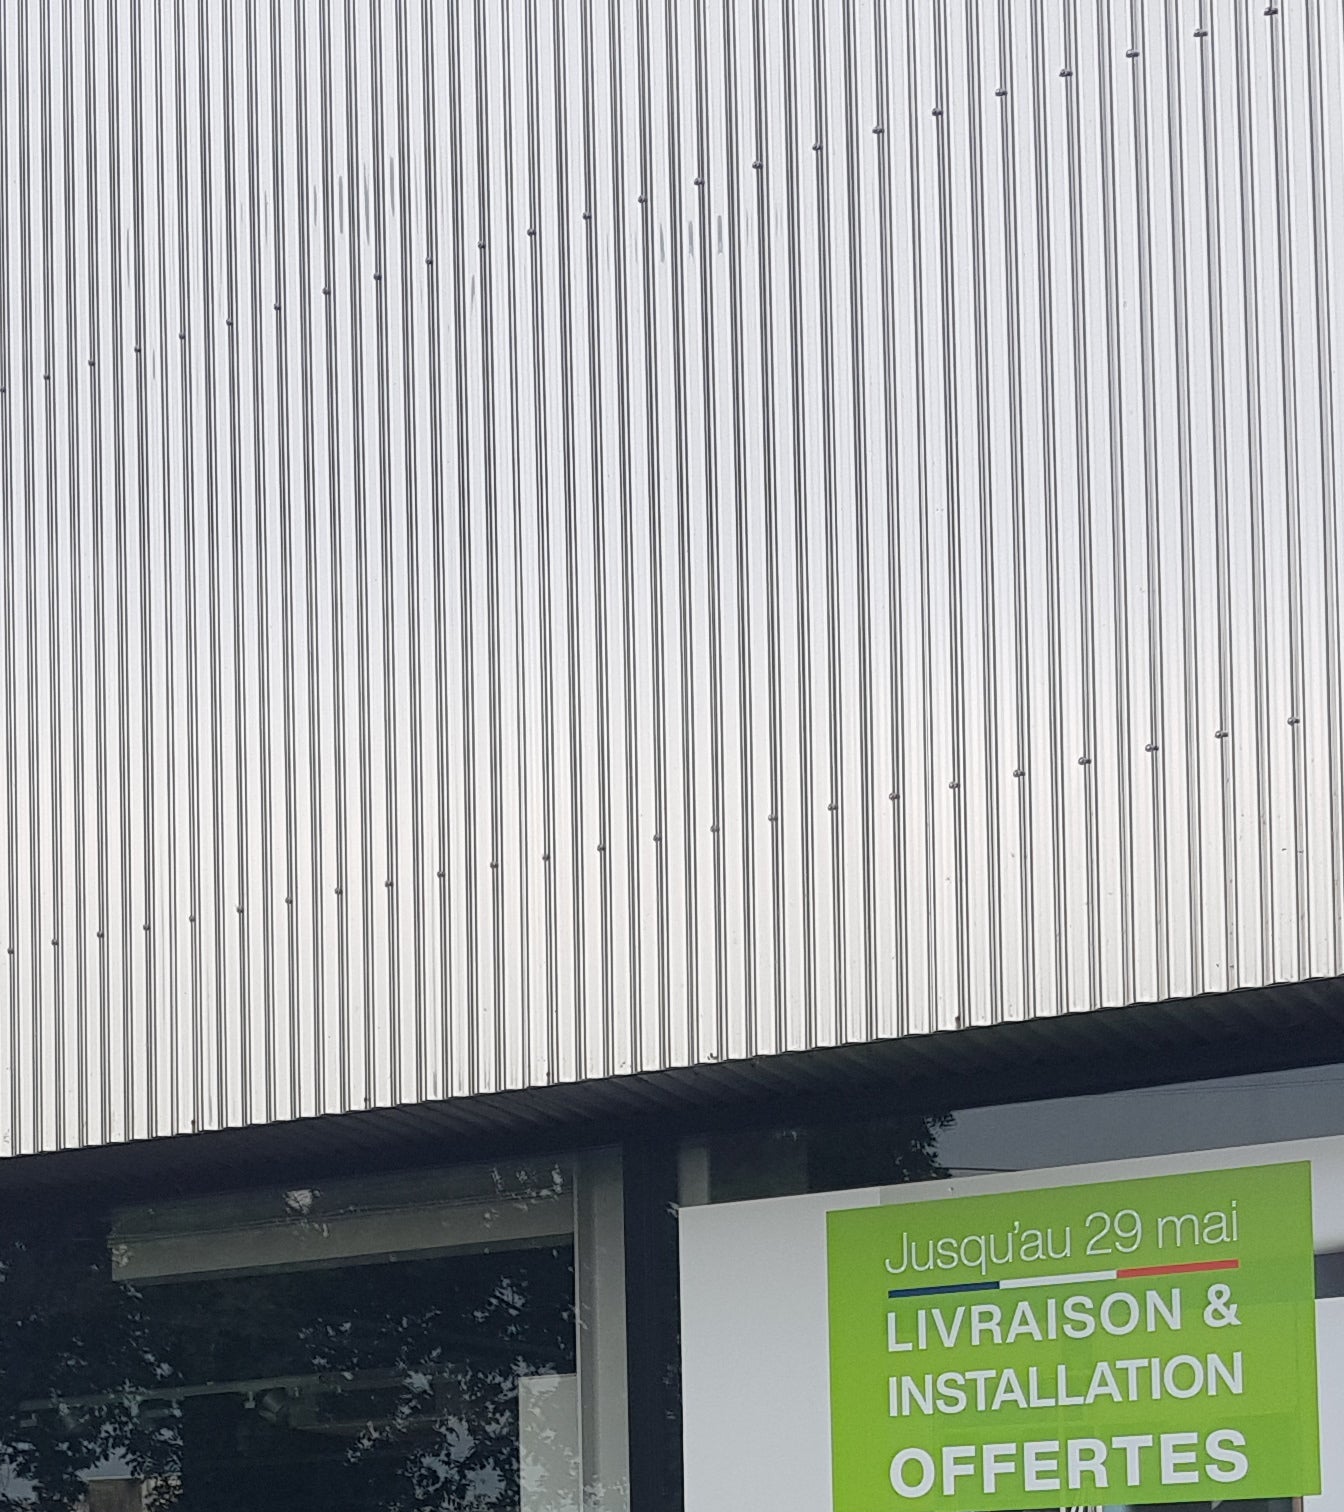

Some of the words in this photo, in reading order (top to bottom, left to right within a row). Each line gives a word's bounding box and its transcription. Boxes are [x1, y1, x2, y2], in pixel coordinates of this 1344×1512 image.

[884, 1220, 1072, 1277] Jusqu'au
[1084, 1208, 1143, 1256] 29
[1157, 1200, 1239, 1249] mai
[887, 1287, 1183, 1353] LIVRAISON
[1202, 1282, 1242, 1328] &
[887, 1351, 1244, 1418] INSTALLATION
[888, 1428, 1250, 1499] OFFERTES
